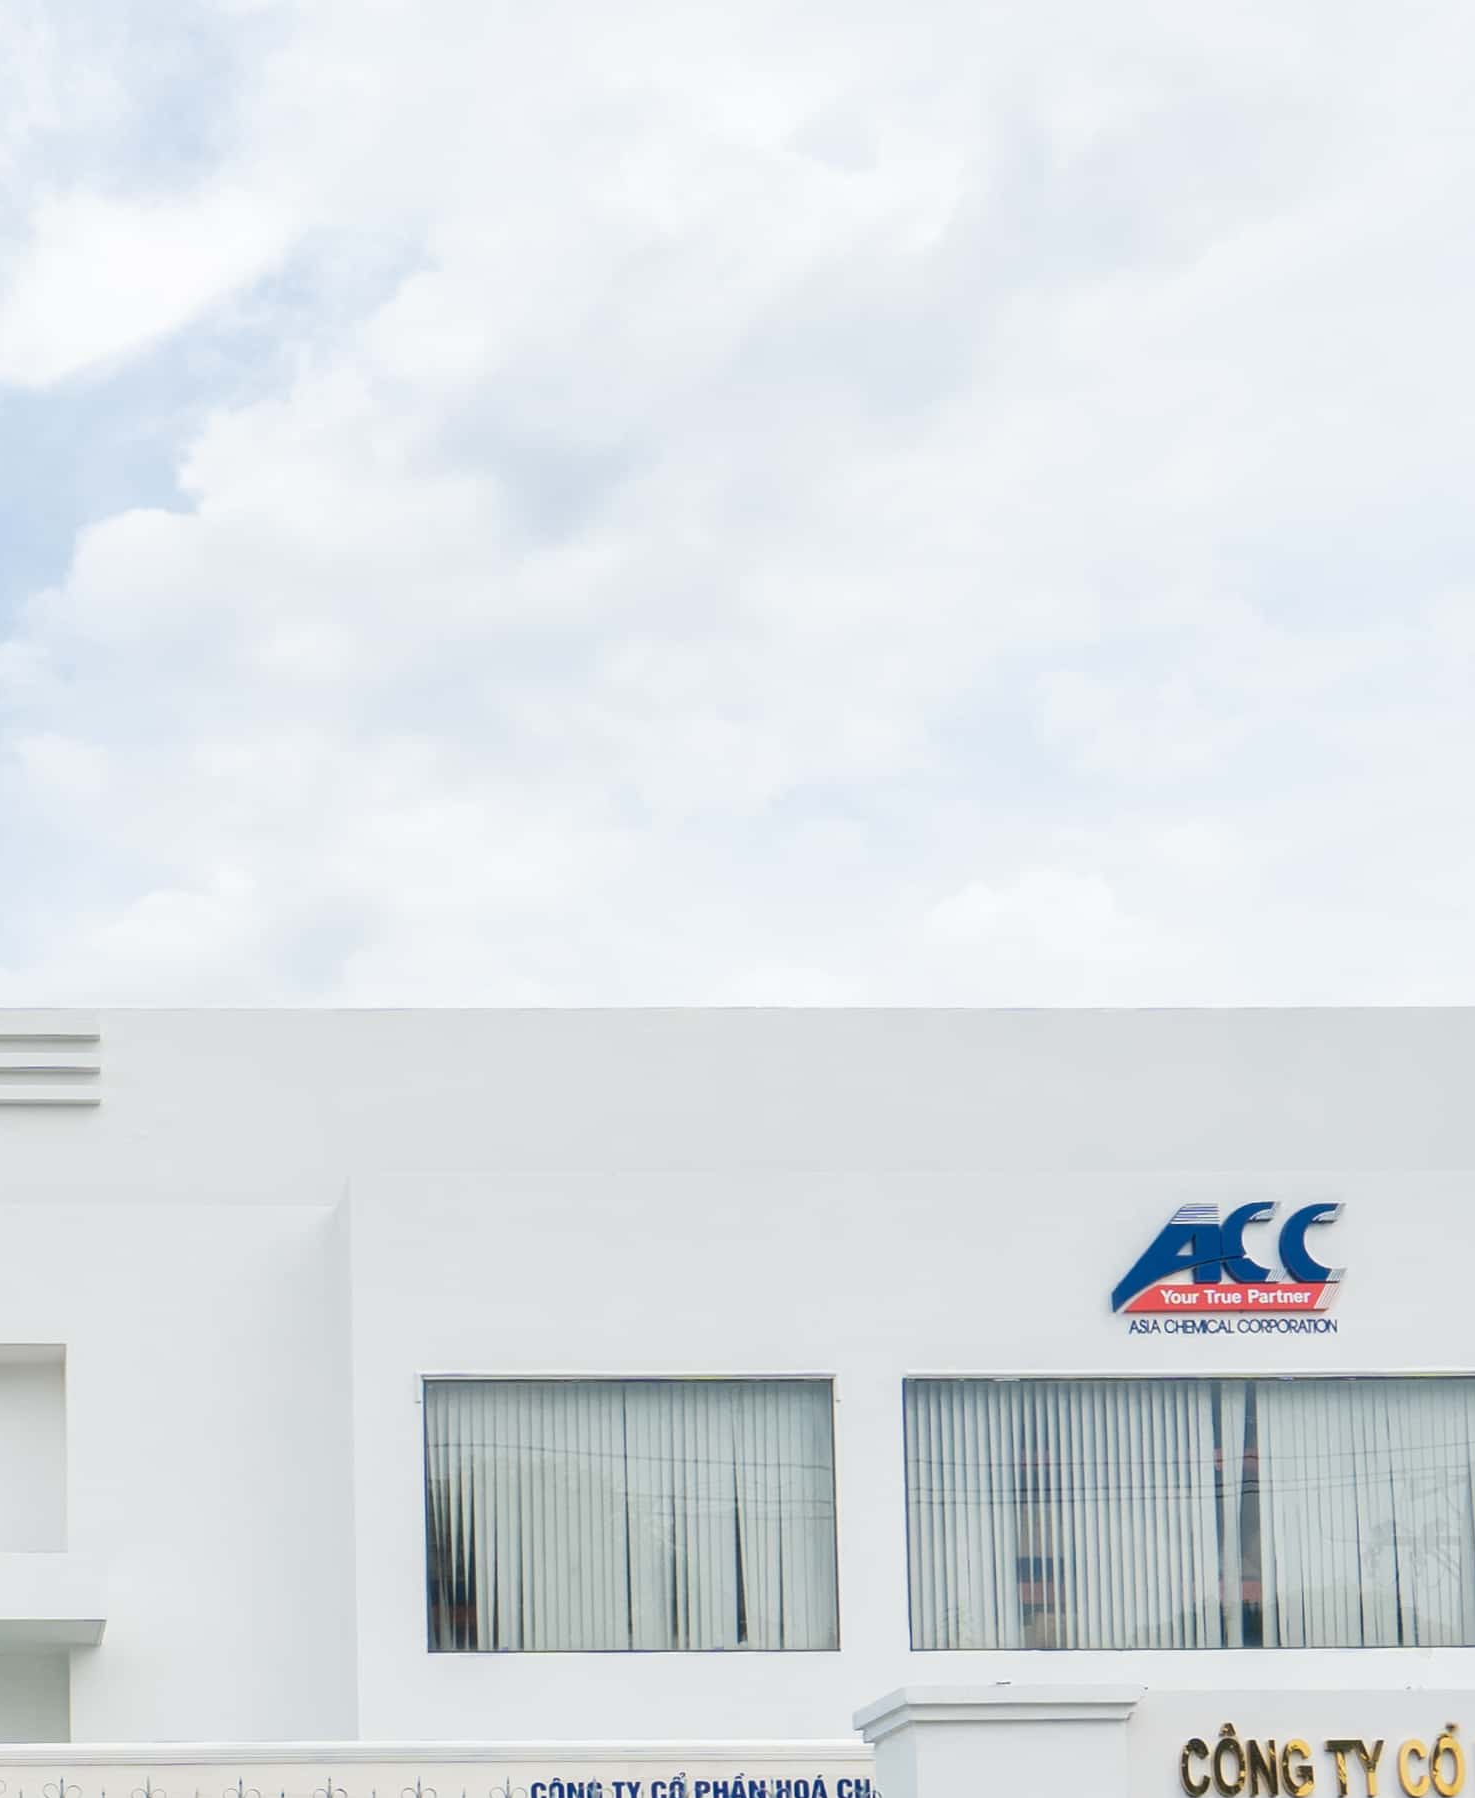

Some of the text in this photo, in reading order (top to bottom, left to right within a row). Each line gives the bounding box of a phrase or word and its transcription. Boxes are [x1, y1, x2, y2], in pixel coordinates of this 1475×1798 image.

[1111, 1201, 1346, 1312] ACC
[1160, 1288, 1311, 1305] Your True Partner
[1129, 1319, 1338, 1335] ASIA CHEMICAL CORPORATION
[1180, 1722, 1316, 1798] CÔNG
[1324, 1738, 1385, 1798] TY
